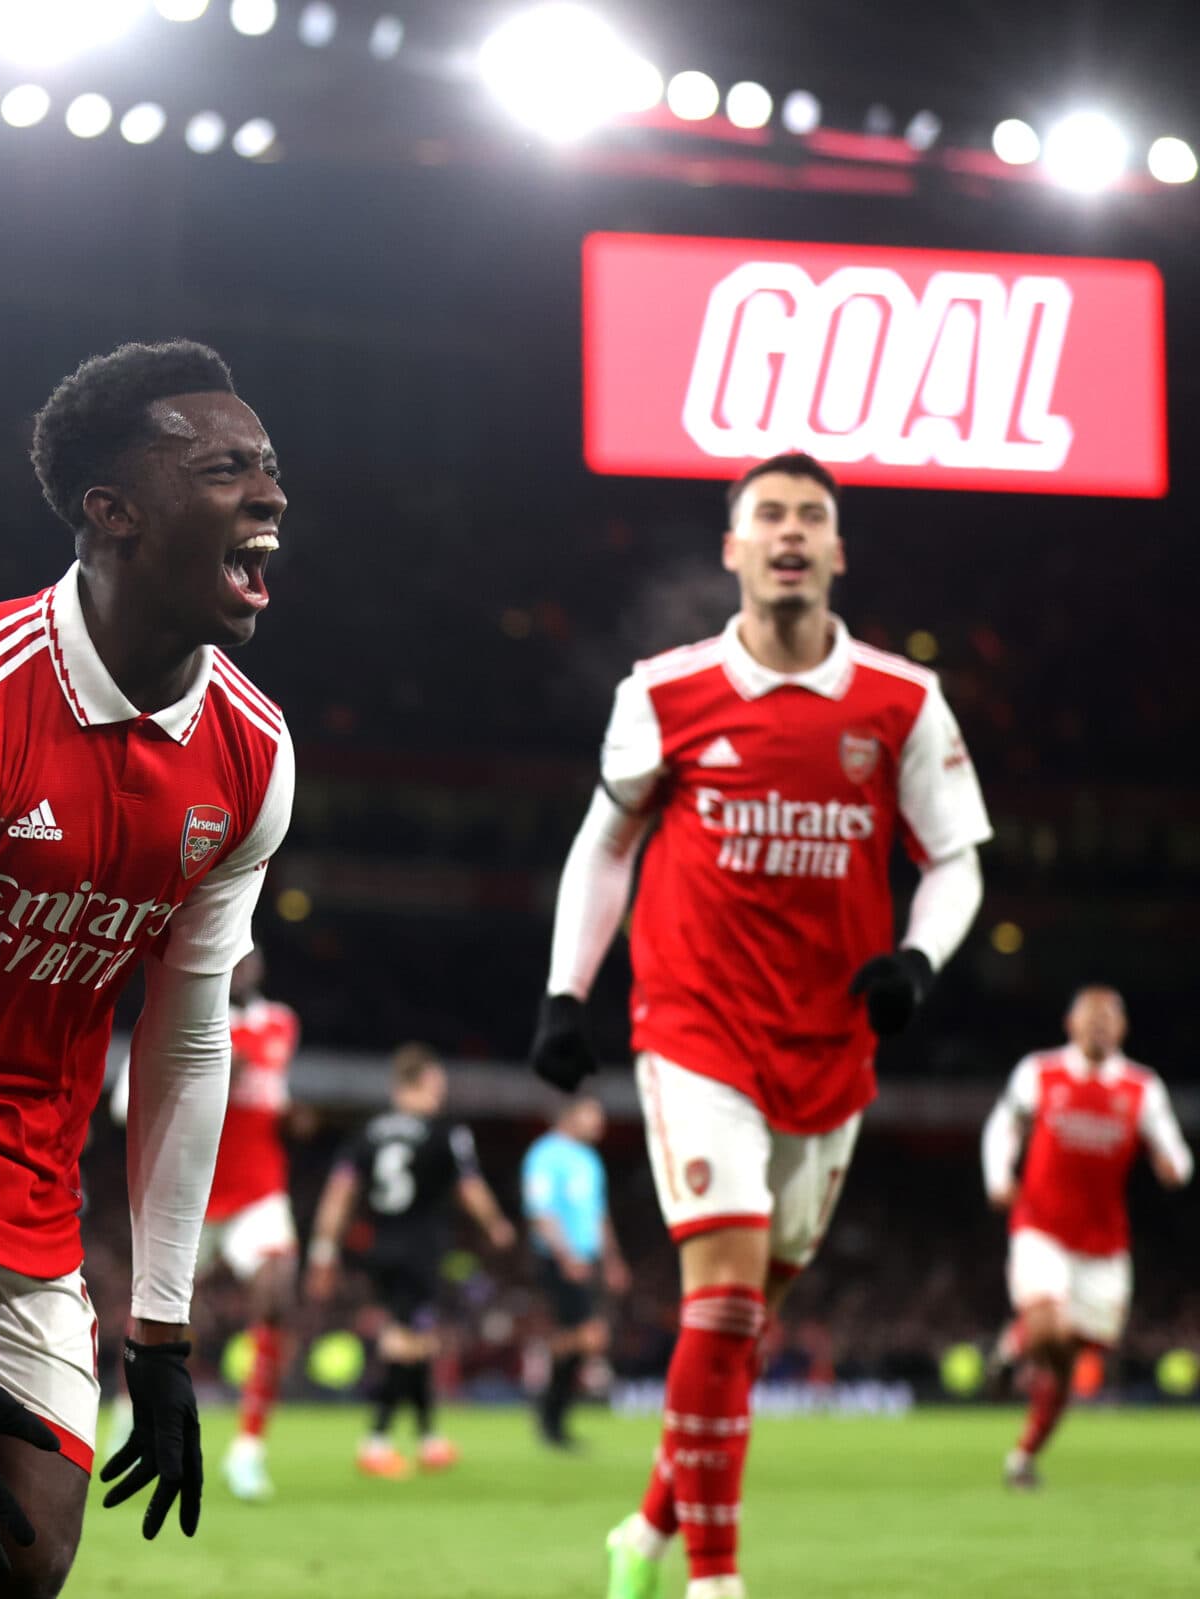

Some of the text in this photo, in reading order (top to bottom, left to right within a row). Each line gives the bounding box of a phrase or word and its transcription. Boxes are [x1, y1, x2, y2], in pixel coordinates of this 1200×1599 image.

[682, 261, 1073, 472] GOAL
[190, 816, 224, 833] Arsenal
[696, 787, 874, 840] Emirates
[7, 824, 63, 841] adidas
